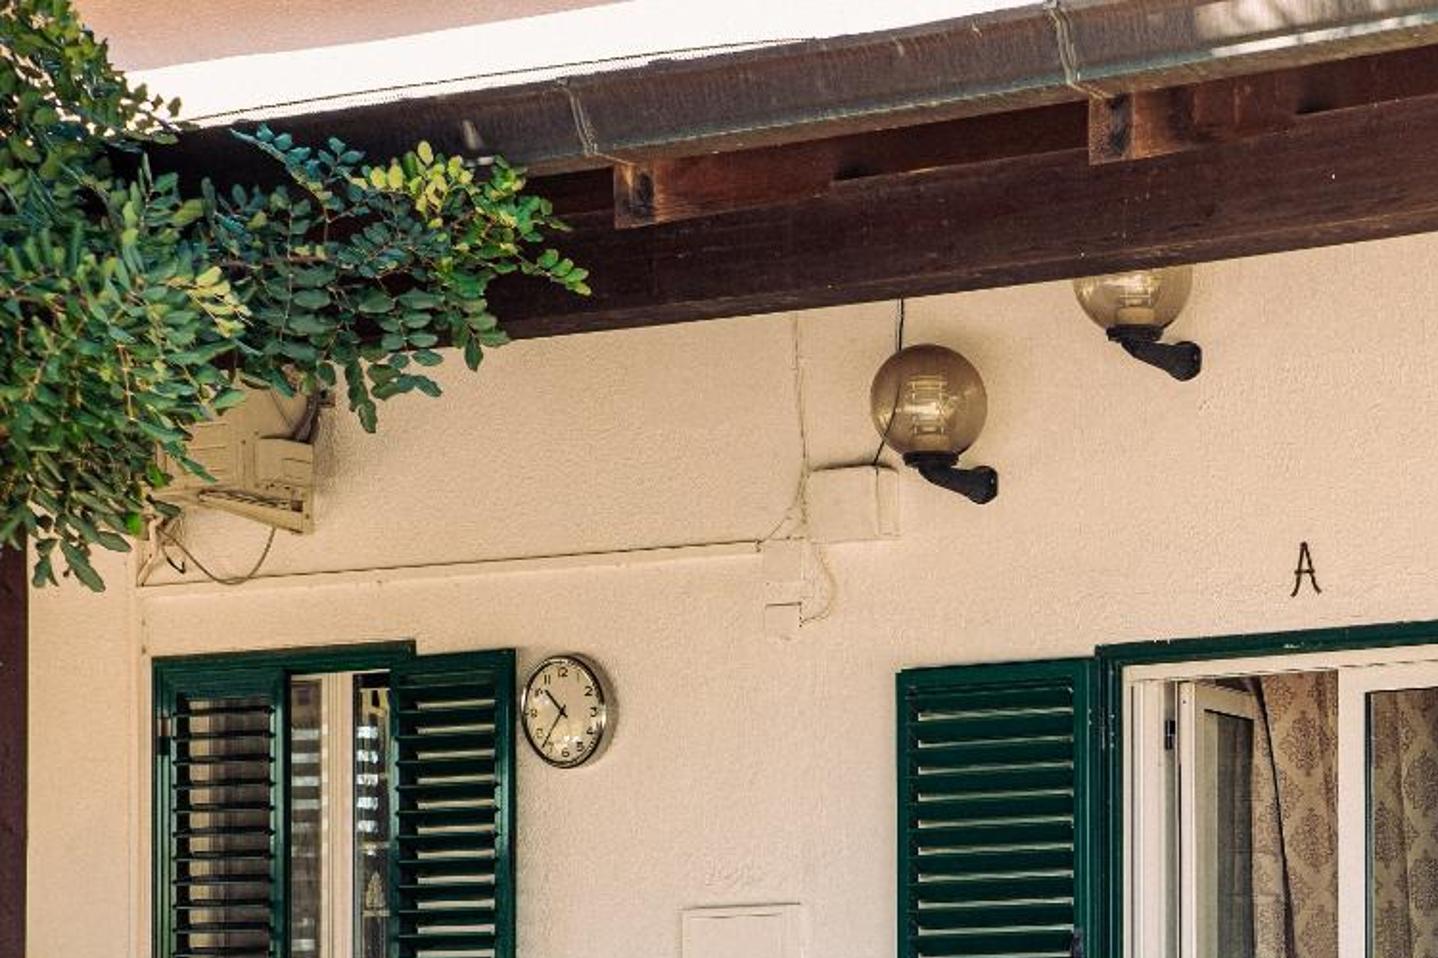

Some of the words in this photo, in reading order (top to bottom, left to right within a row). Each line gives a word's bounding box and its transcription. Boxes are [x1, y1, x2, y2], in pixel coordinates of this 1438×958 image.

[1290, 541, 1322, 598] A
[557, 666, 569, 678] 12
[544, 674, 551, 685] 11
[584, 685, 593, 697] 2
[590, 706, 599, 718] 3
[561, 747, 570, 758] 6
